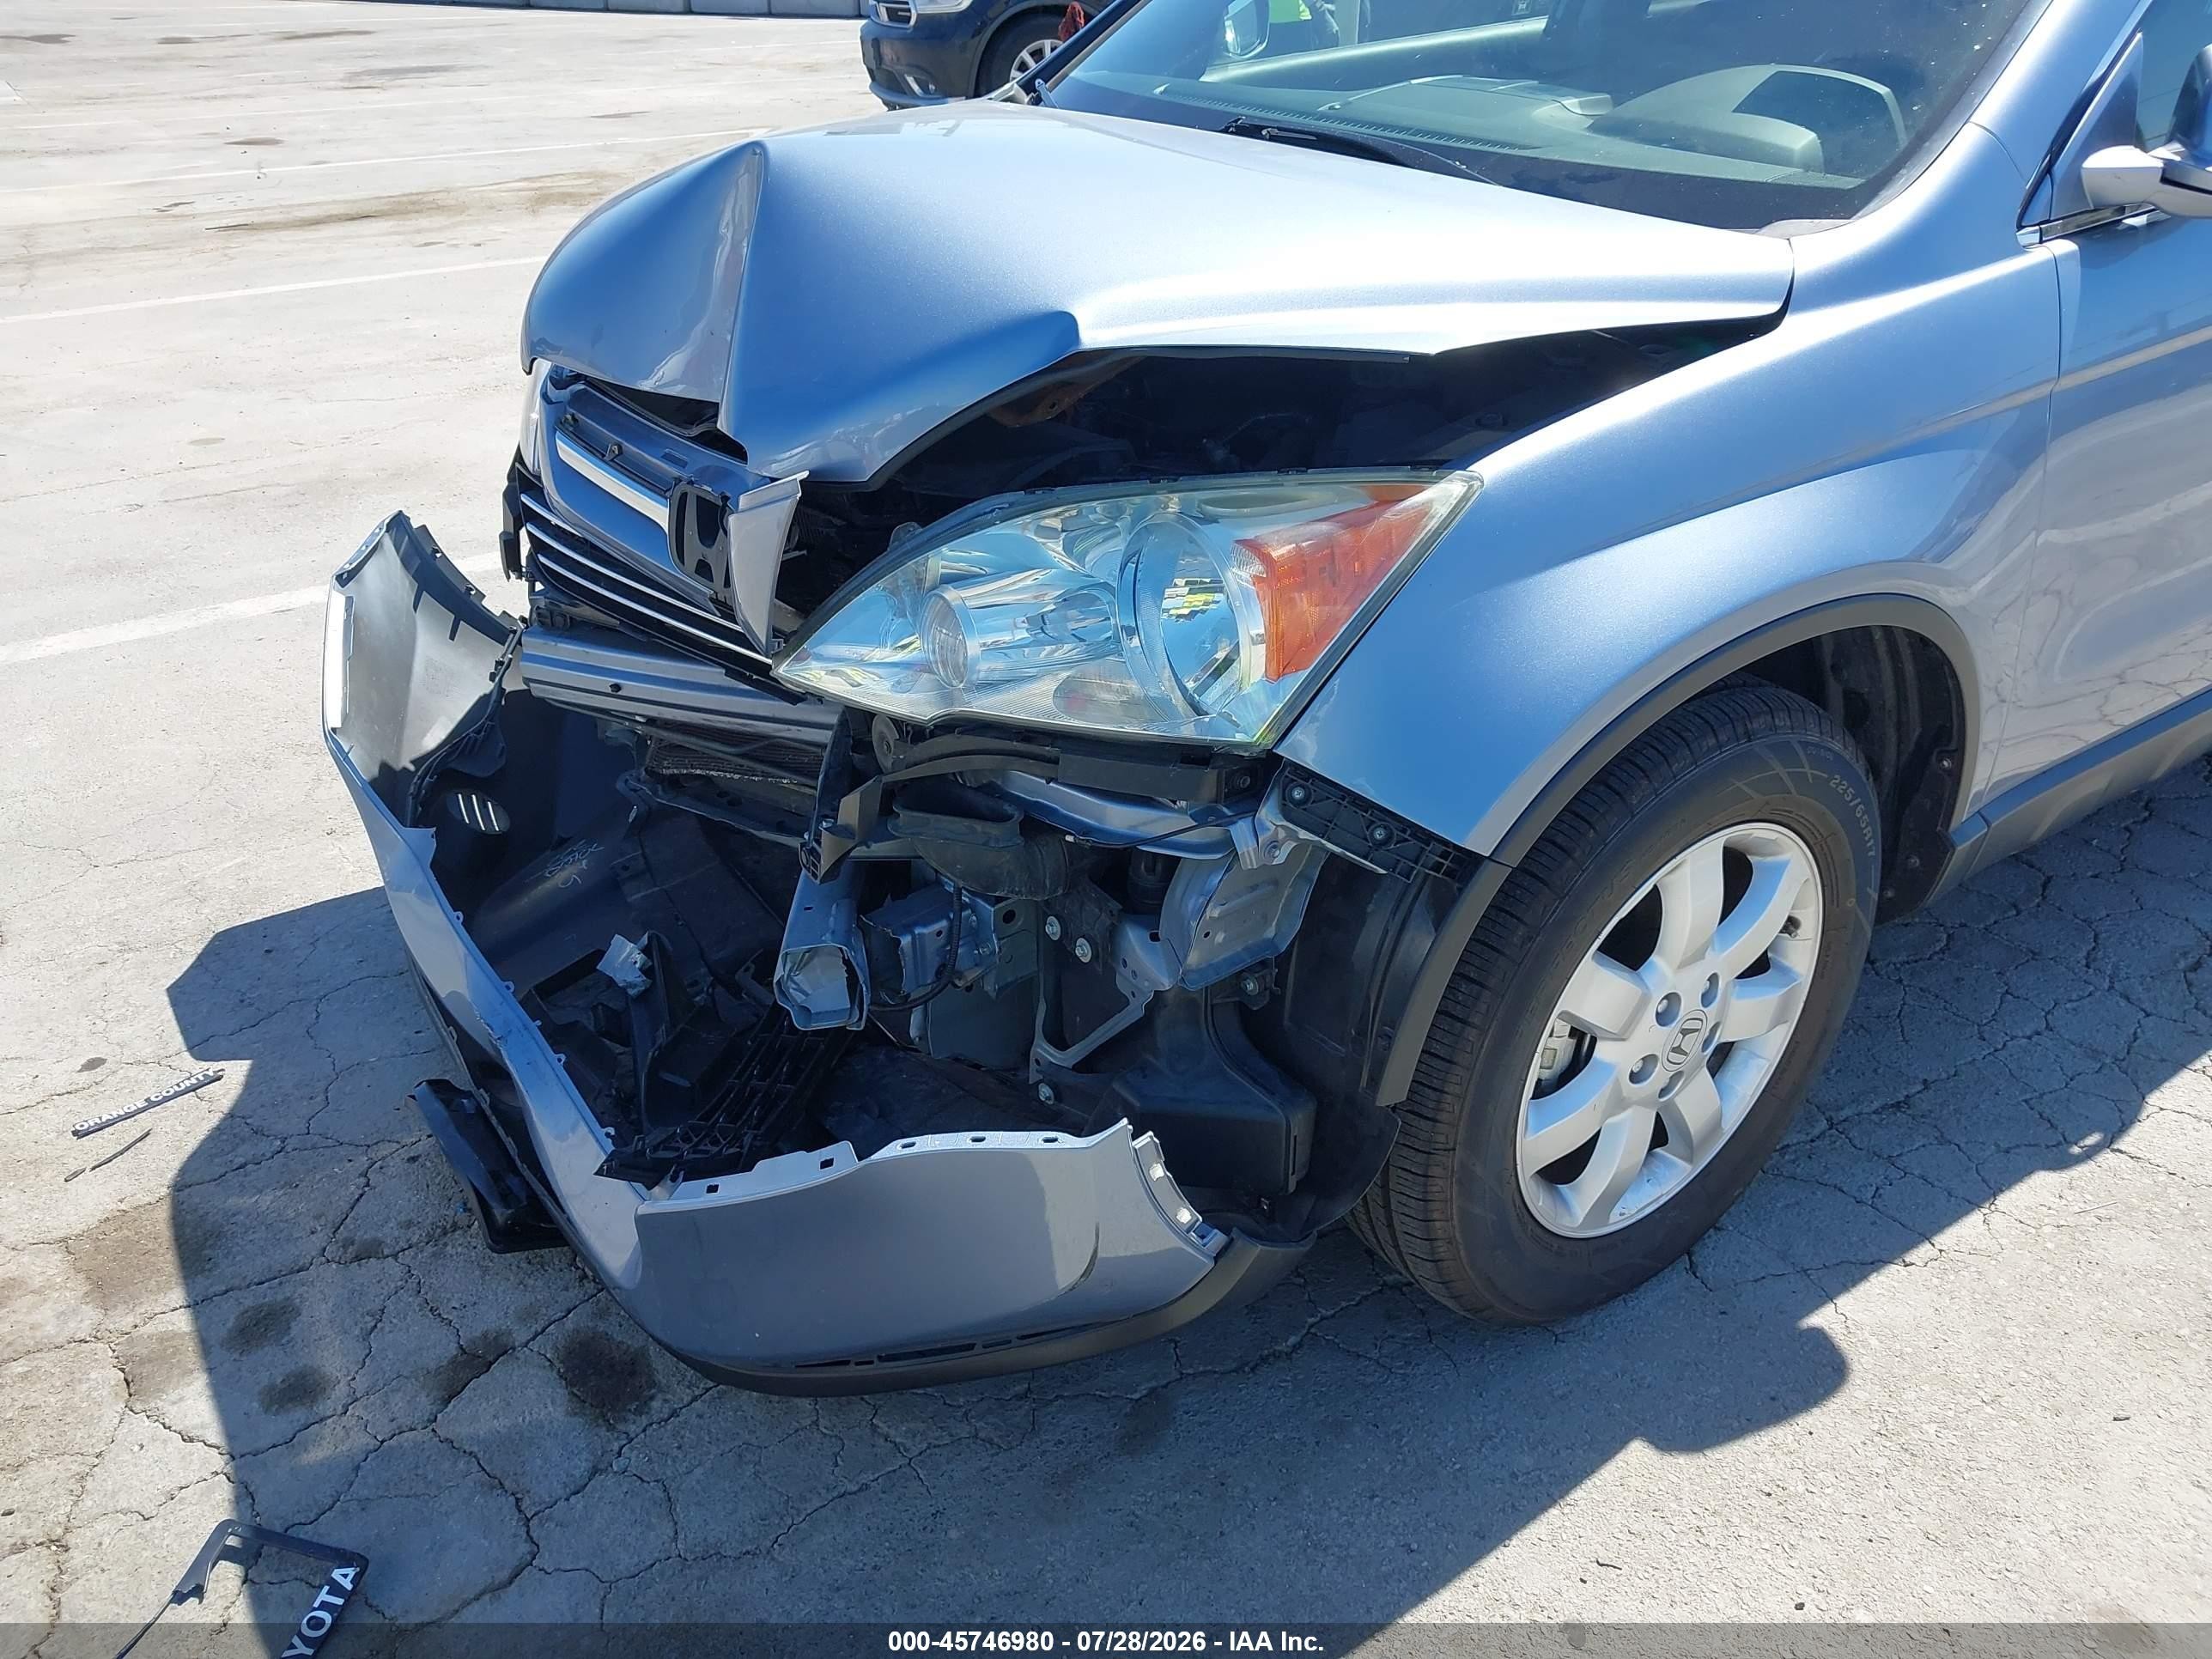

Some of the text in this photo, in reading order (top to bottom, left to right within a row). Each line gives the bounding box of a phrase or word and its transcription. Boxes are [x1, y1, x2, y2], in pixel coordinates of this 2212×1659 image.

[1829, 775, 1876, 856] 225/65R17
[74, 1067, 216, 1132] ORANGE COUNTY
